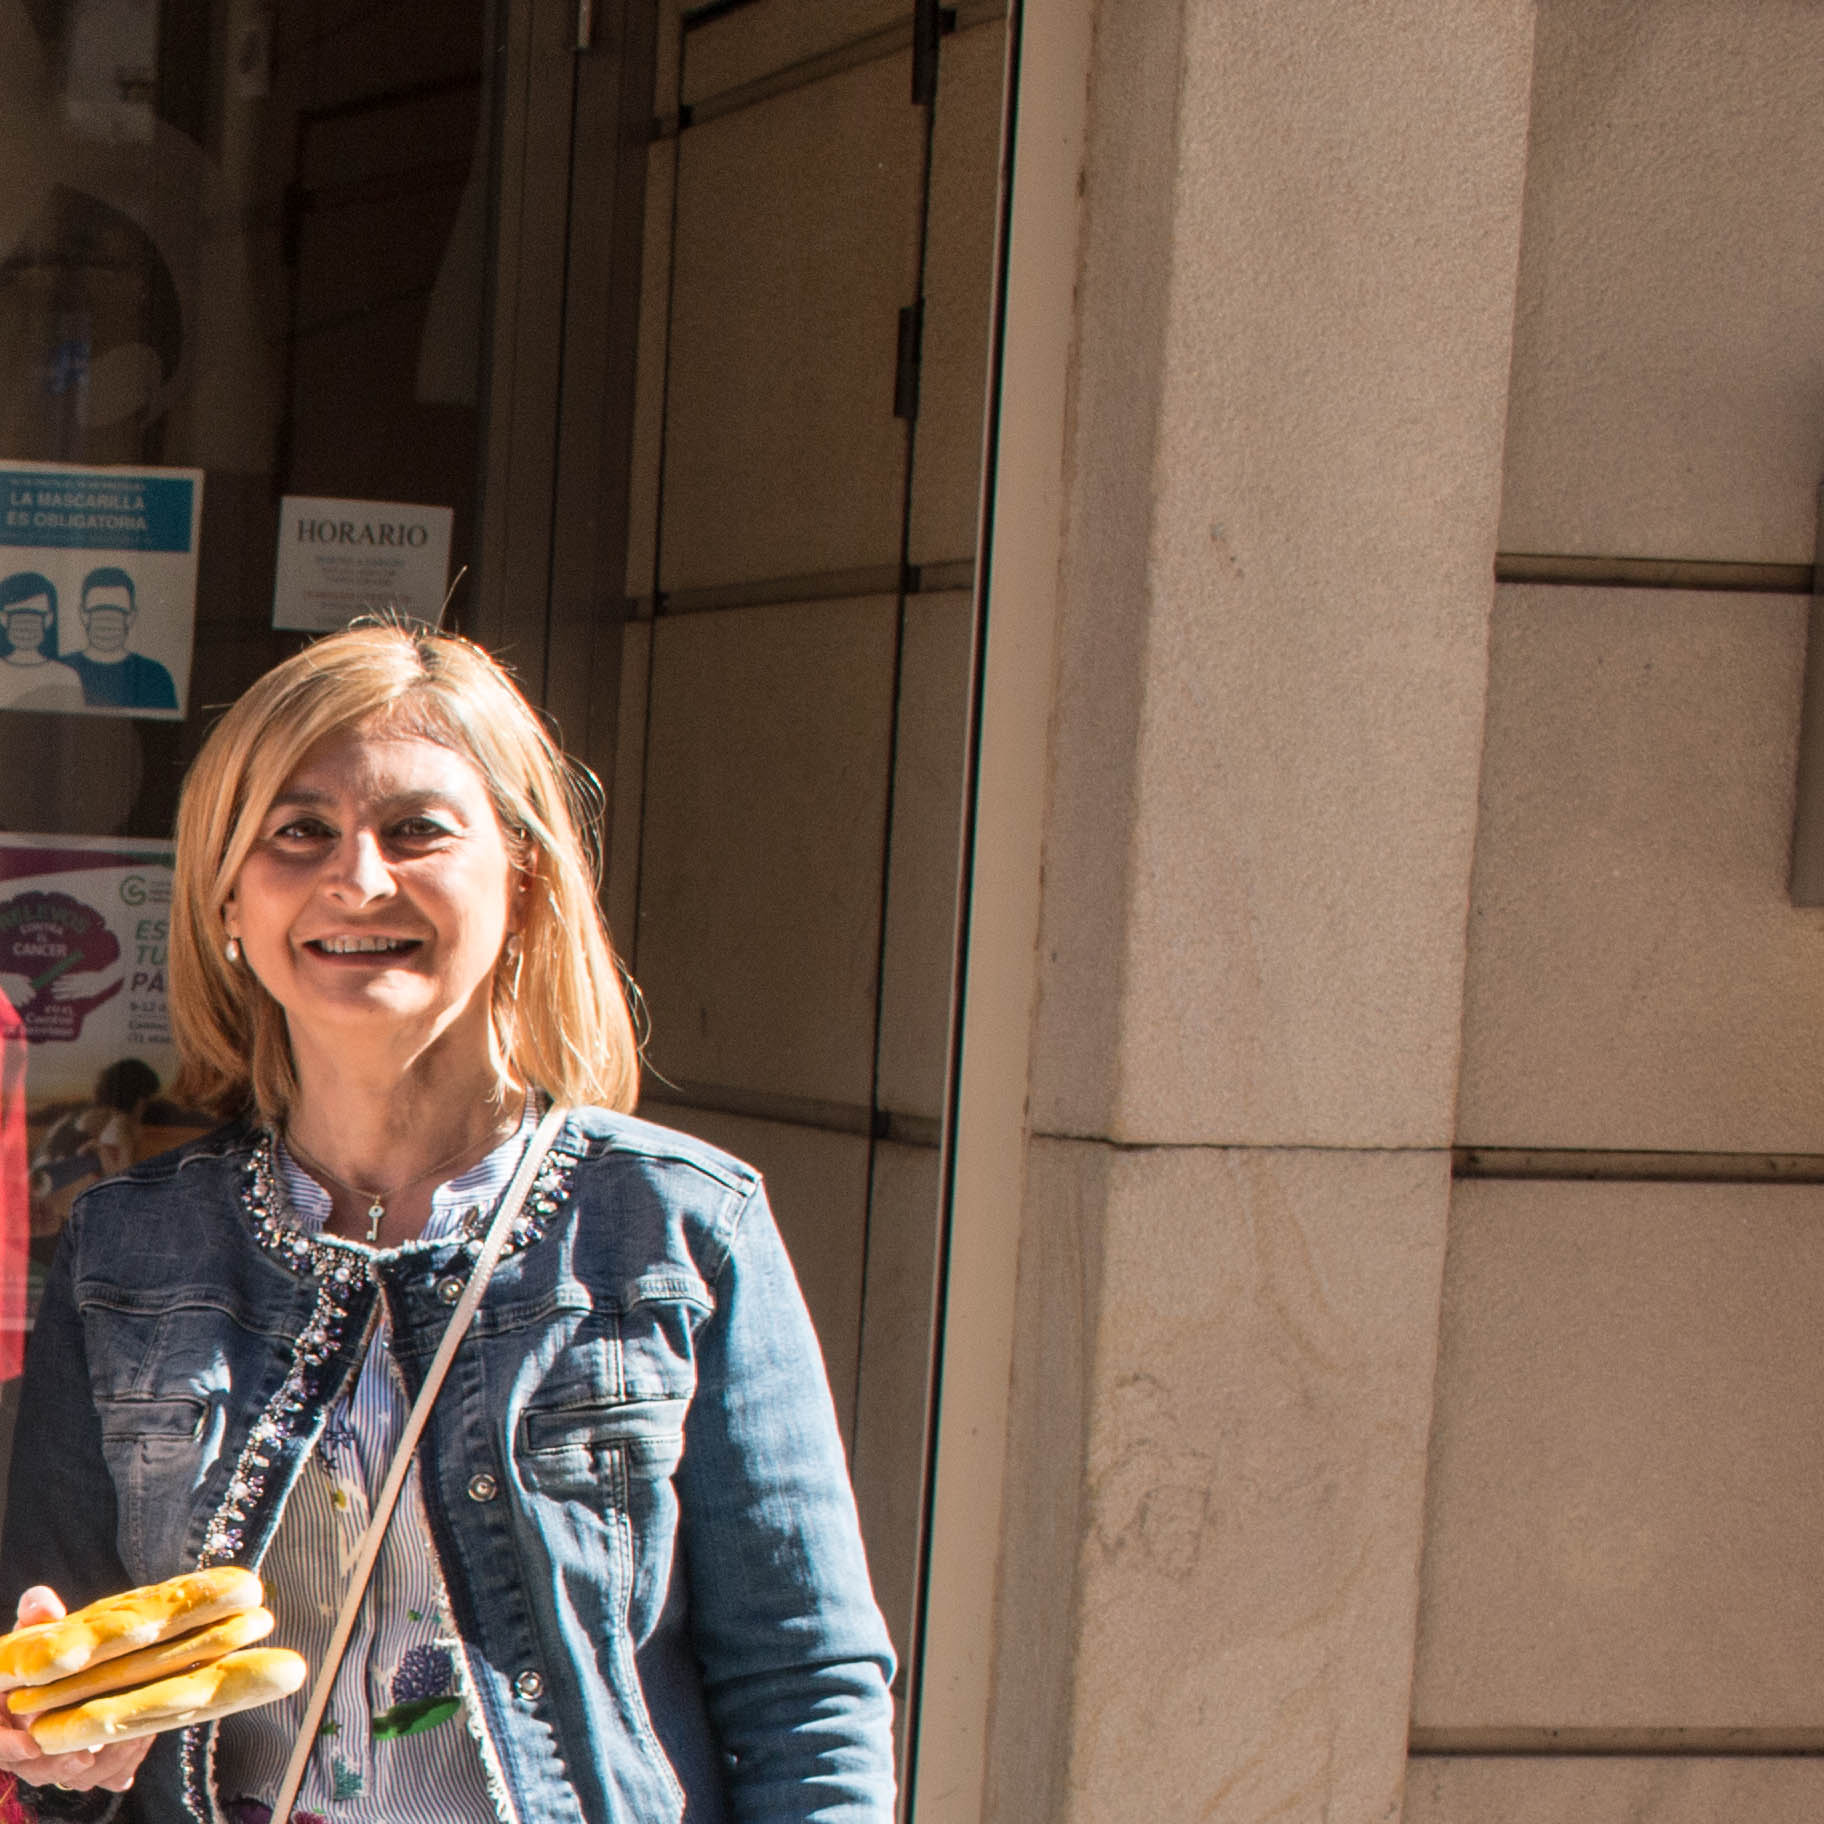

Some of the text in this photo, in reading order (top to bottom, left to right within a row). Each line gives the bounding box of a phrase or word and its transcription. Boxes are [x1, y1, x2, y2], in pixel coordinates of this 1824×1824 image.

[10, 491, 145, 510] LA MASCARILLA
[7, 511, 147, 530] ES OBLIGATORIA
[297, 519, 429, 548] HORARIO
